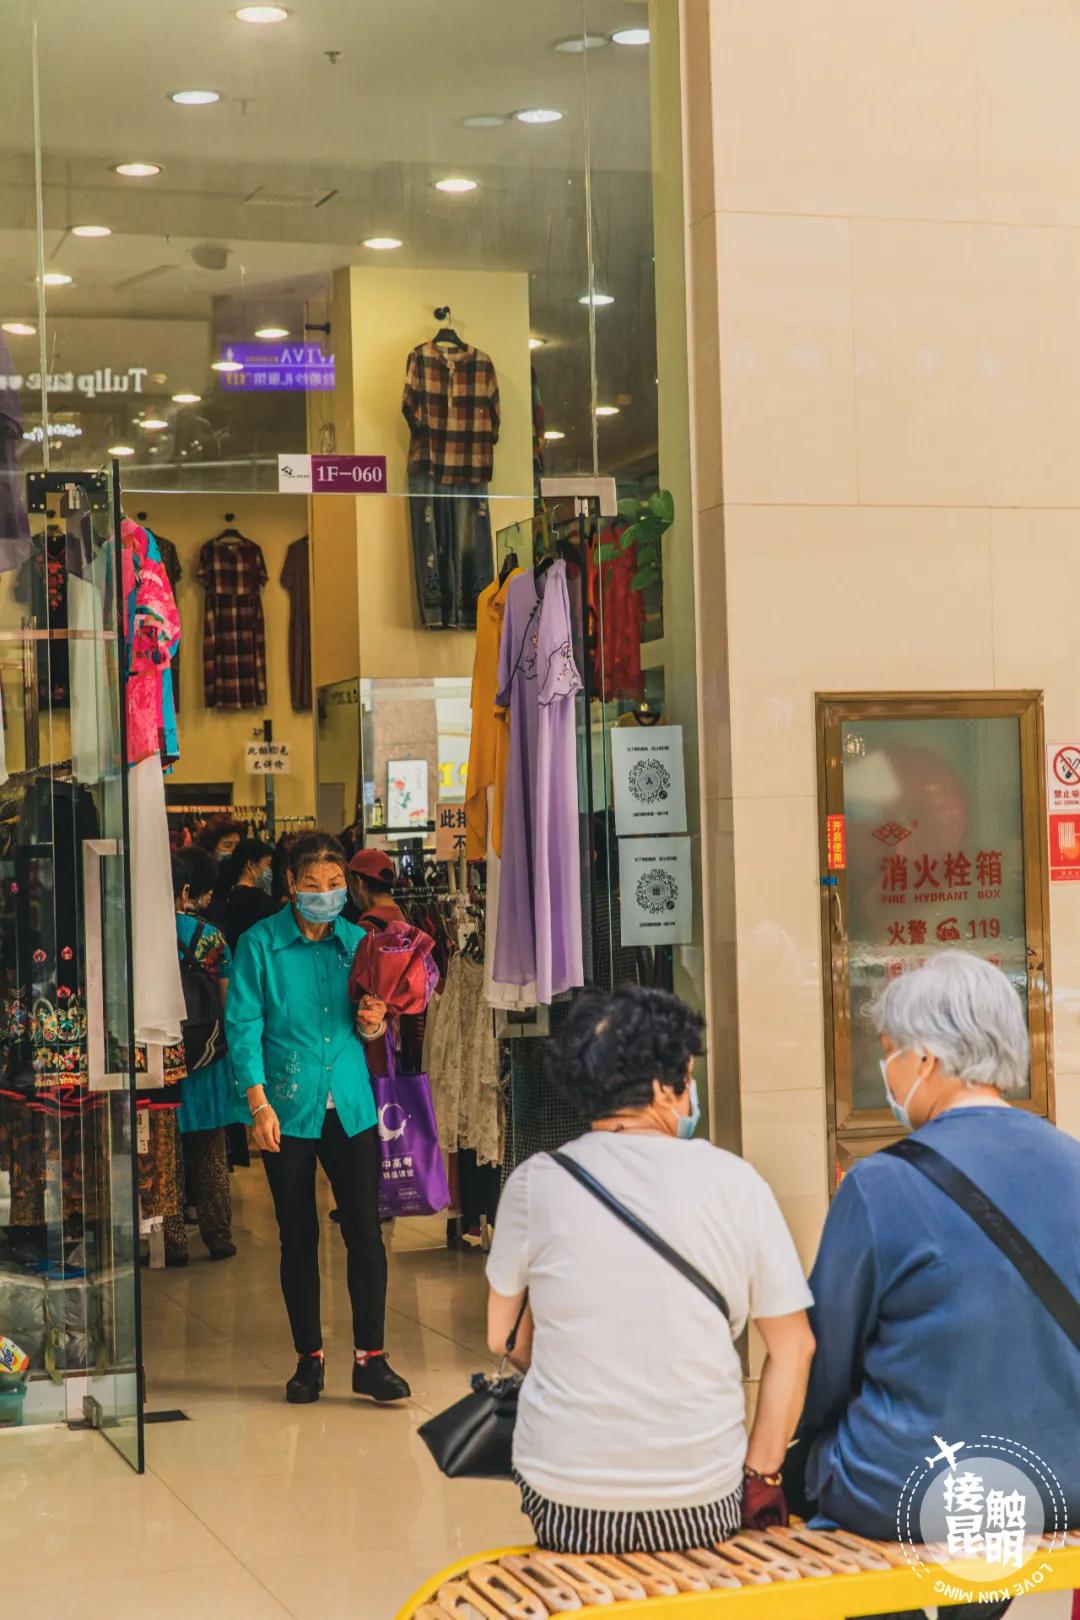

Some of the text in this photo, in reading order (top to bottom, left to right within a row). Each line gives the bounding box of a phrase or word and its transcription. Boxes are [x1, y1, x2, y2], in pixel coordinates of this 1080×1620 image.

[880, 850, 1002, 891] 消火栓箱
[881, 889, 1001, 905] FIRE HYDRANT BOX
[887, 918, 1001, 946] 火警 119
